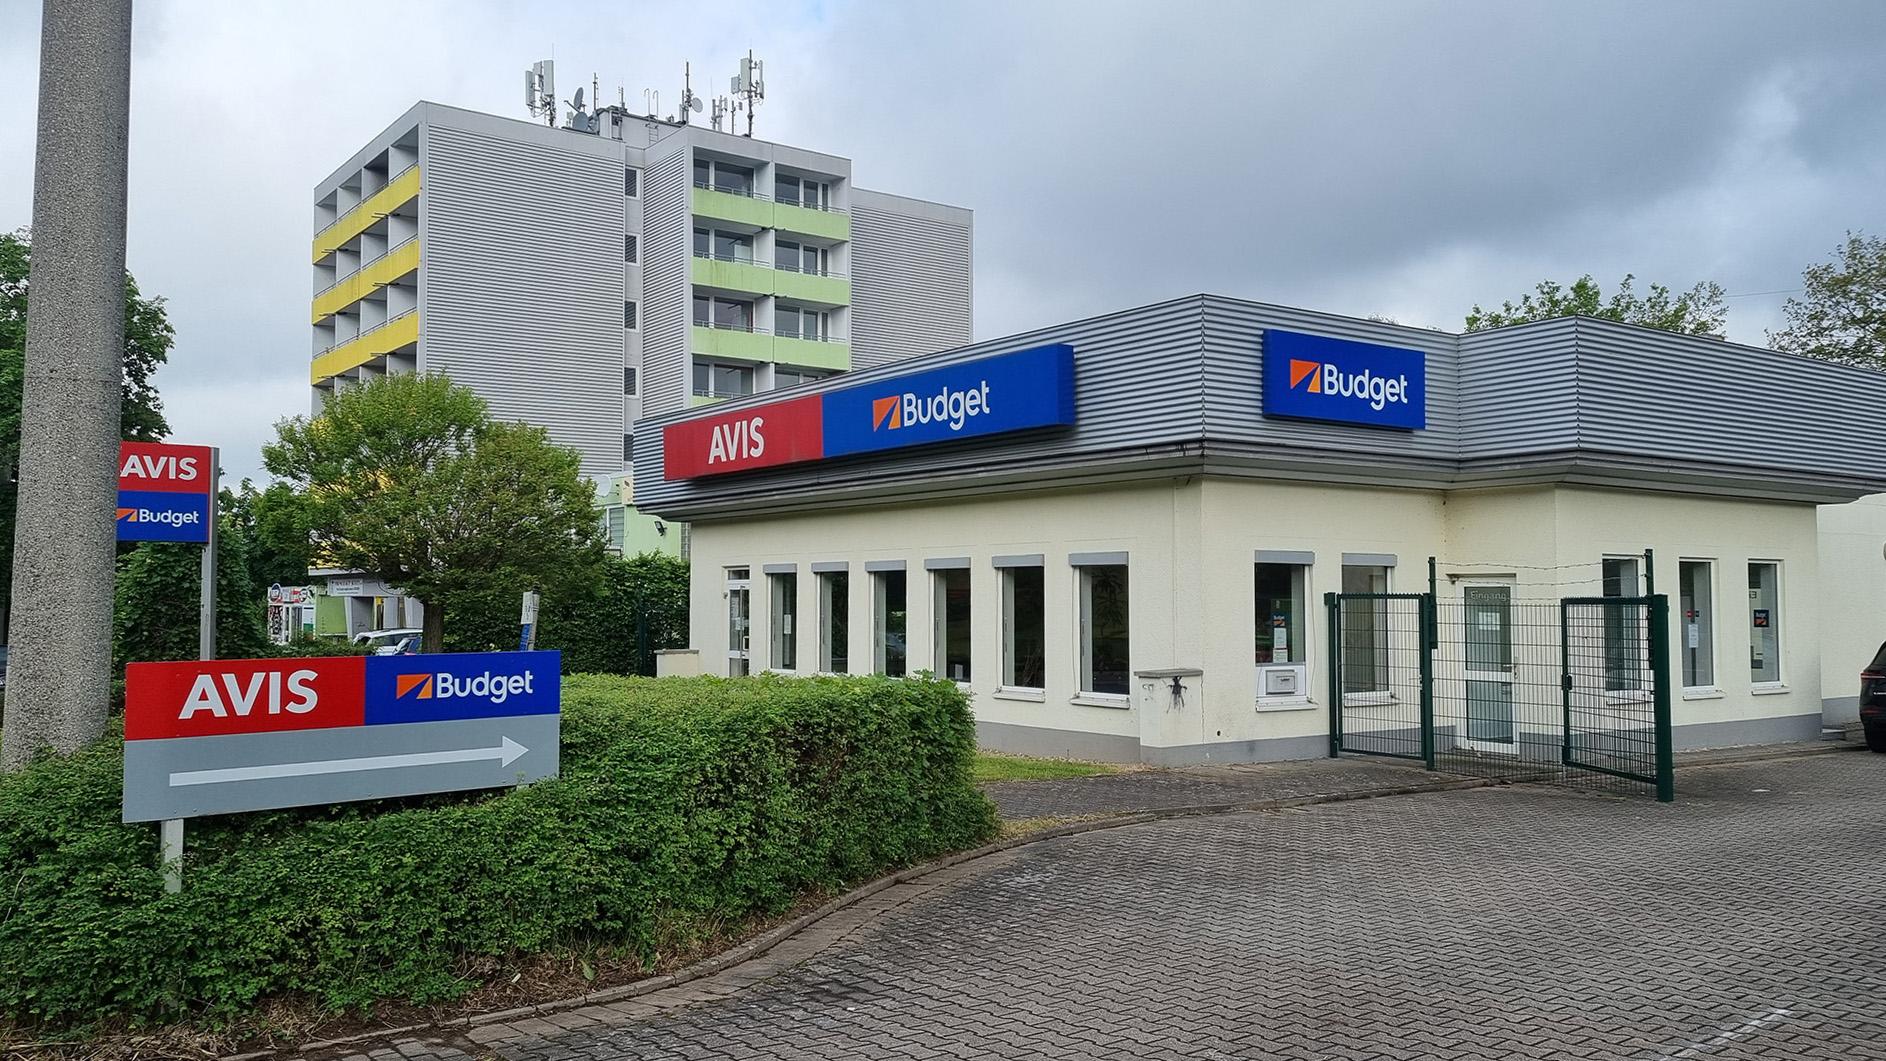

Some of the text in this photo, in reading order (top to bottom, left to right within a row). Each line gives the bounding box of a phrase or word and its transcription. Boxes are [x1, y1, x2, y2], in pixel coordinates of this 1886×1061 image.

[1323, 363, 1408, 411] Budget
[708, 380, 990, 465] AVIS Budget
[119, 454, 198, 481] AVIS
[139, 508, 199, 528] Budget
[1470, 590, 1507, 602] Eingang
[177, 669, 534, 720] AVIS Budget
